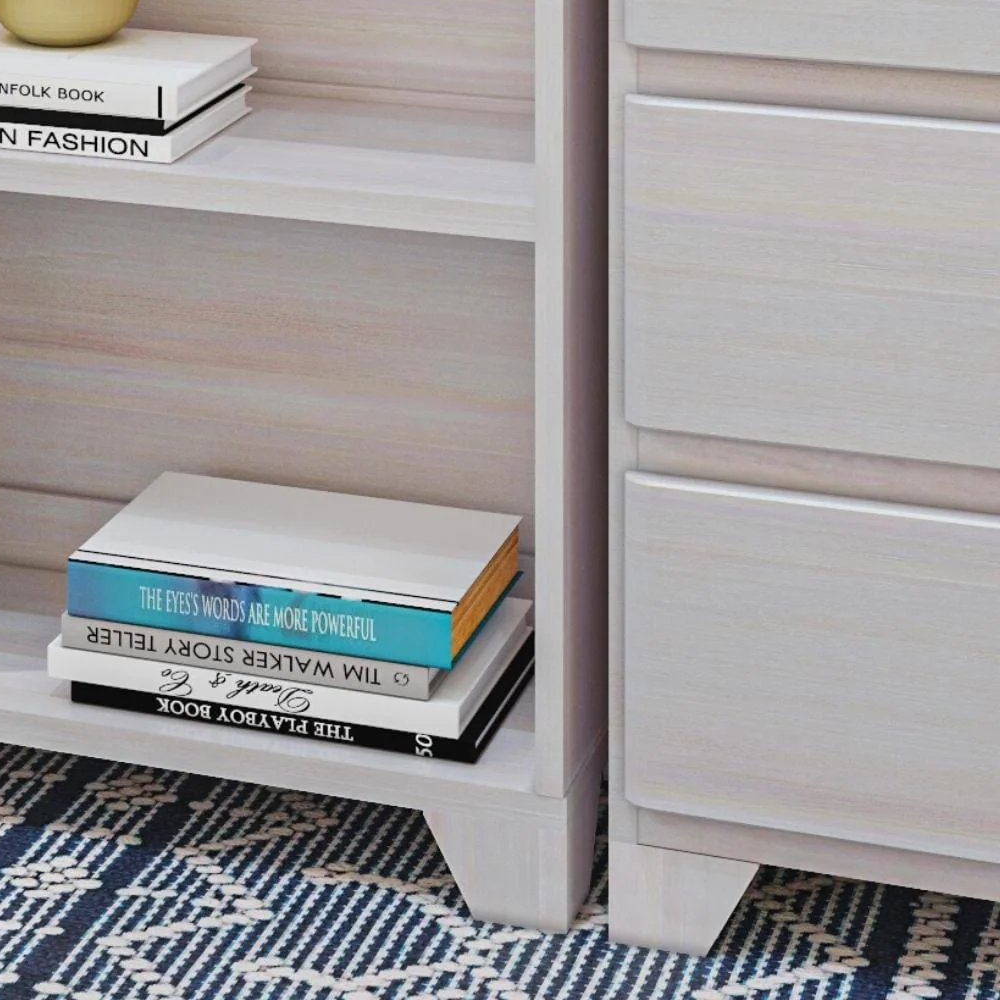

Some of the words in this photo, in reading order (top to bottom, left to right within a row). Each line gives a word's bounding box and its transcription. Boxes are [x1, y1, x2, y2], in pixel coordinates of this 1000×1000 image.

[57, 87, 105, 103] BOOK
[27, 130, 149, 158] FASHION
[139, 586, 162, 611] THE
[166, 590, 198, 616] EYES'S
[201, 595, 246, 623] WORDS
[248, 602, 270, 626] ARE
[273, 607, 308, 632] MORE
[311, 612, 377, 641] POWERFUL
[87, 626, 158, 652] TELLER
[164, 638, 234, 663] STORY
[242, 650, 334, 679] WALKER
[343, 663, 381, 685] TIM
[158, 669, 193, 697] Co
[226, 677, 314, 713] Death
[156, 698, 212, 720] BOOK
[217, 707, 309, 734] PLAYBOY
[313, 722, 354, 742] THE
